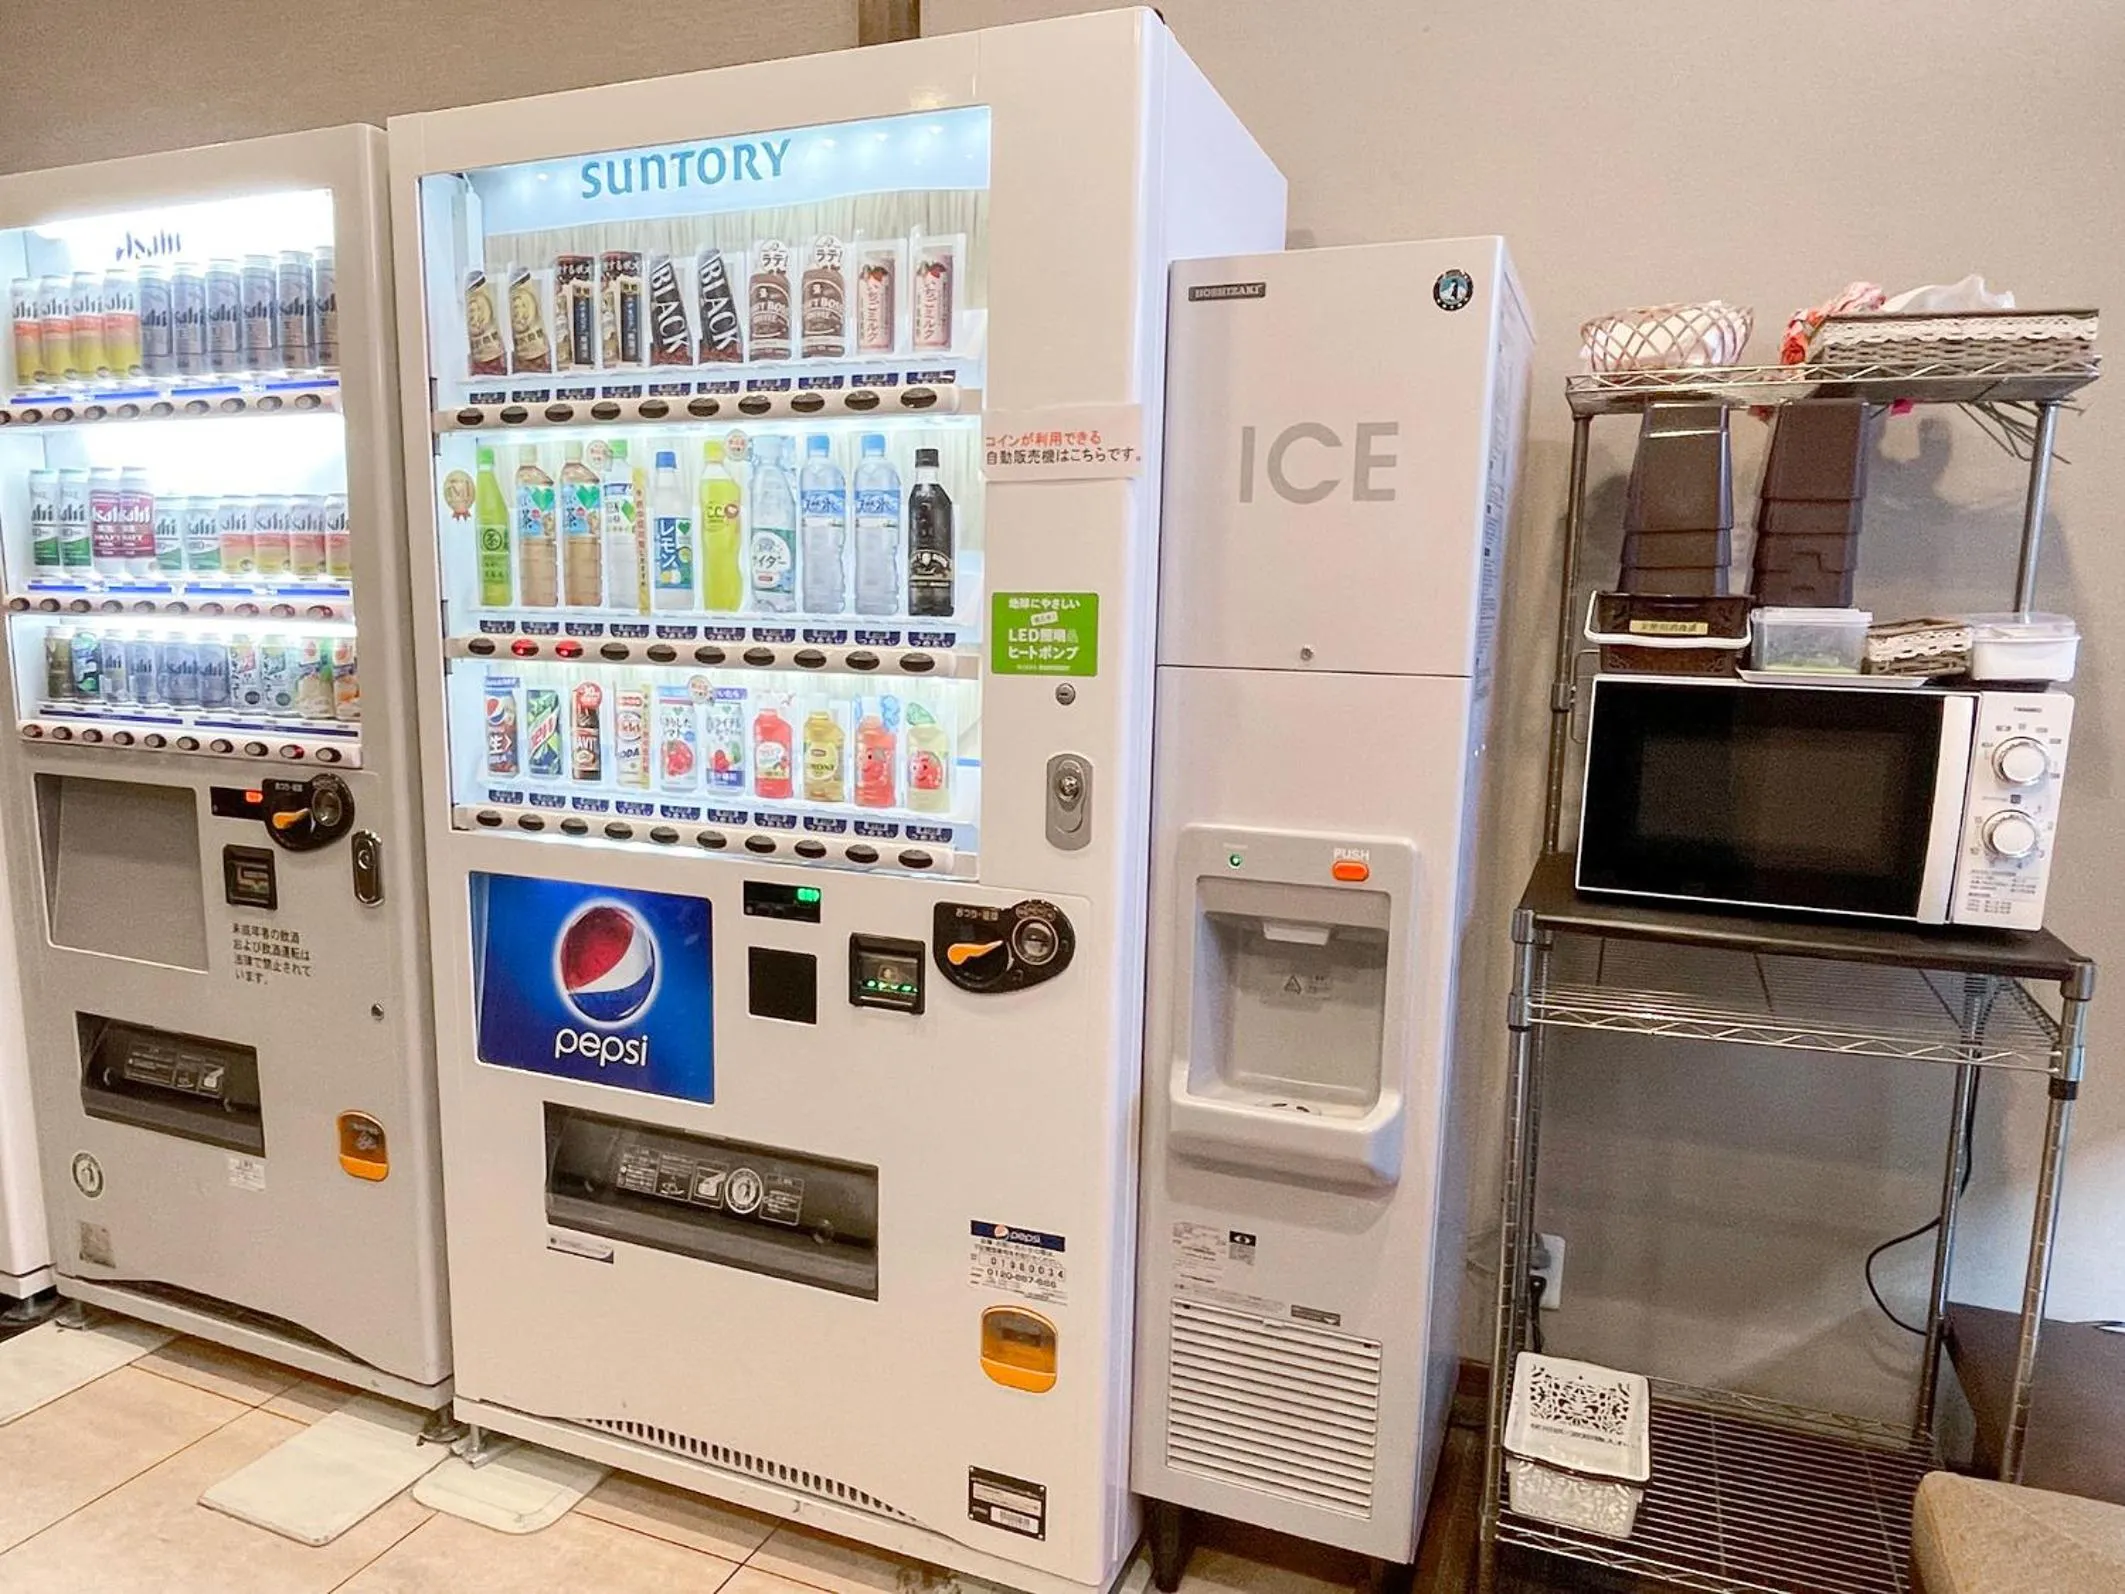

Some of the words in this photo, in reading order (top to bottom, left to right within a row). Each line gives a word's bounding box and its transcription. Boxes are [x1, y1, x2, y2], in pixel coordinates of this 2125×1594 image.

[650, 257, 689, 354] BLACK
[699, 252, 740, 351] BLACK
[986, 431, 1102, 448] コインが利用できる
[986, 448, 1141, 466] 自動販売機はこちらです。
[1239, 421, 1399, 505] ICE
[660, 519, 678, 569] レモン
[1008, 645, 1079, 660] ヒートポンプ
[1332, 847, 1371, 862] PUSH
[554, 1027, 649, 1067] pepsi
[1010, 1231, 1041, 1243] pepsi
